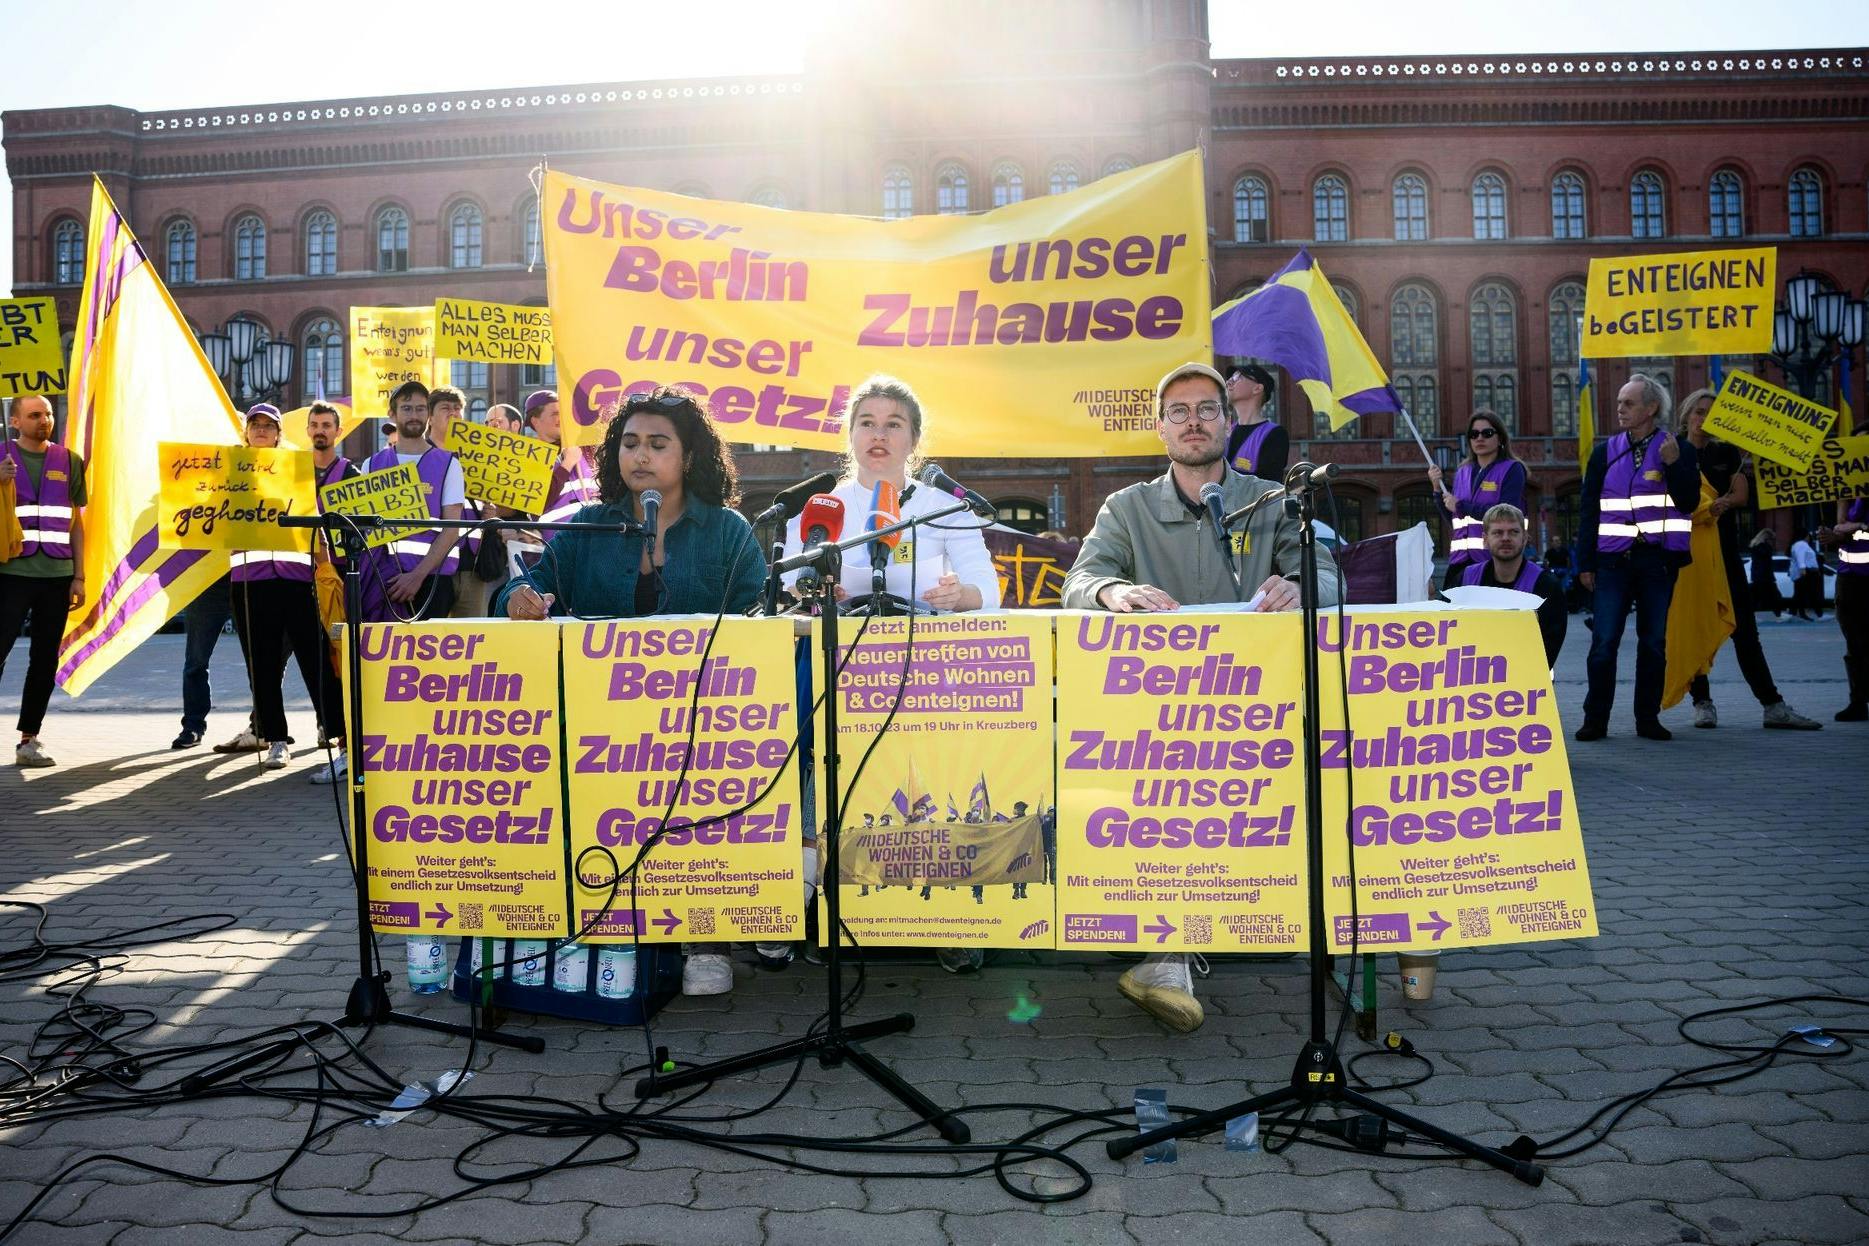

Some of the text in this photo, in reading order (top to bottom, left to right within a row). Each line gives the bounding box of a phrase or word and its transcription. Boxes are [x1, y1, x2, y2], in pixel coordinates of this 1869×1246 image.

[557, 188, 743, 240] Unser
[989, 233, 1187, 284] unser
[603, 245, 808, 302] Berlin
[1608, 257, 1764, 296] ENTEIGNEN
[442, 321, 479, 337] MAN
[857, 289, 1184, 347] Zuhause
[1590, 305, 1759, 336] beGEISTERT
[625, 325, 812, 377] unser
[2, 369, 66, 394] TUN
[376, 370, 421, 381] werden
[572, 368, 851, 434] Getz!
[1096, 389, 1158, 403] DEUTSCH
[1727, 376, 1832, 431] ENTEIGNUNG
[1088, 403, 1152, 417] WOHNEN
[1758, 413, 1781, 428] man
[1104, 418, 1158, 431] ENTEIG
[172, 451, 278, 480] jetzt wird
[325, 467, 411, 506] ENTEIGNEN
[173, 498, 293, 537] geghosted
[912, 618, 1007, 634] anmelden:
[1077, 616, 1220, 652] Unser
[1317, 615, 1457, 652] Unser
[360, 626, 485, 661] Unser
[582, 623, 713, 659] Unser
[840, 644, 1026, 666] Neuentreffen von
[607, 656, 757, 701] Berlin
[838, 667, 1030, 688] Deutsche Wohnen
[1103, 653, 1263, 696] Berlin
[1348, 645, 1507, 695] Berlin
[384, 662, 523, 702] Berlin
[849, 691, 1018, 712] & Co enteignen!
[1406, 688, 1546, 728] unser
[433, 709, 552, 736] unser
[659, 703, 789, 734] unser
[855, 722, 900, 734] 18.1023
[903, 724, 921, 732] um
[924, 721, 935, 731] 19
[940, 720, 960, 731] Uhr
[963, 720, 973, 730] in
[976, 719, 1038, 732] Kreuzberg
[1157, 702, 1296, 732] unser
[363, 734, 551, 773] Zuhause
[575, 733, 789, 773] Zuhause
[1064, 730, 1294, 771] Zuhause
[1320, 723, 1552, 769] Zuhause
[412, 779, 532, 806] unser
[637, 776, 767, 807] unser
[1132, 778, 1272, 807] unser
[1389, 762, 1533, 803] unser
[373, 805, 553, 844] Gesetz!
[596, 804, 791, 847] Gesetz!
[1085, 805, 1296, 849] Gesetz!
[1346, 789, 1562, 847] Gesetz!
[876, 829, 951, 847] DEUTSCHE
[416, 856, 496, 869] Weiter geht's:
[869, 845, 977, 862] WOHNEN & CO
[1400, 853, 1500, 871] Weiter geht's:
[381, 868, 414, 878] einem
[418, 868, 556, 881] Gesetzesvolksentscheid
[582, 873, 601, 884] Mit
[644, 869, 794, 884] Gesetzesvolksentscheid
[642, 859, 729, 872] Weiter geht's:
[884, 861, 972, 878] ENTEIGNEN
[1135, 862, 1229, 876] Weiter geht's:
[1332, 859, 1576, 887] Mi einem Gesetzesvolksentscheid
[391, 880, 432, 890] endlich
[457, 881, 524, 895] Umsetzung!
[663, 887, 682, 896] zur
[685, 884, 759, 897] Umsetzung!
[1067, 875, 1298, 888] Mit einem Gesetzesvolksentscheid
[1372, 876, 1538, 900] endlich zur Umsetzung!
[369, 903, 391, 912] ETZT
[1104, 890, 1260, 903] endlich zur Umsetzung!
[1512, 900, 1567, 913] DEUTSCHE
[497, 913, 560, 922] WOHNEN & CO
[500, 905, 545, 913] DEUTSCHE
[731, 915, 798, 924] WOHNEN & CO
[735, 906, 782, 915] DEUTSCHE
[1234, 914, 1284, 924] DEUTSCHE
[1508, 909, 1586, 924] WOHNEN & CO
[506, 923, 555, 931] ENTEIGNEN
[741, 925, 792, 934] ENTEIGNEN
[1067, 917, 1102, 927] JETZT
[1229, 924, 1301, 933] WOHNEN & CO
[1337, 918, 1372, 929] JEZT
[1521, 919, 1582, 933] ENTEIGNEN
[1067, 930, 1126, 940] SPENDEN!
[1240, 934, 1295, 944] ENTEIGNEN
